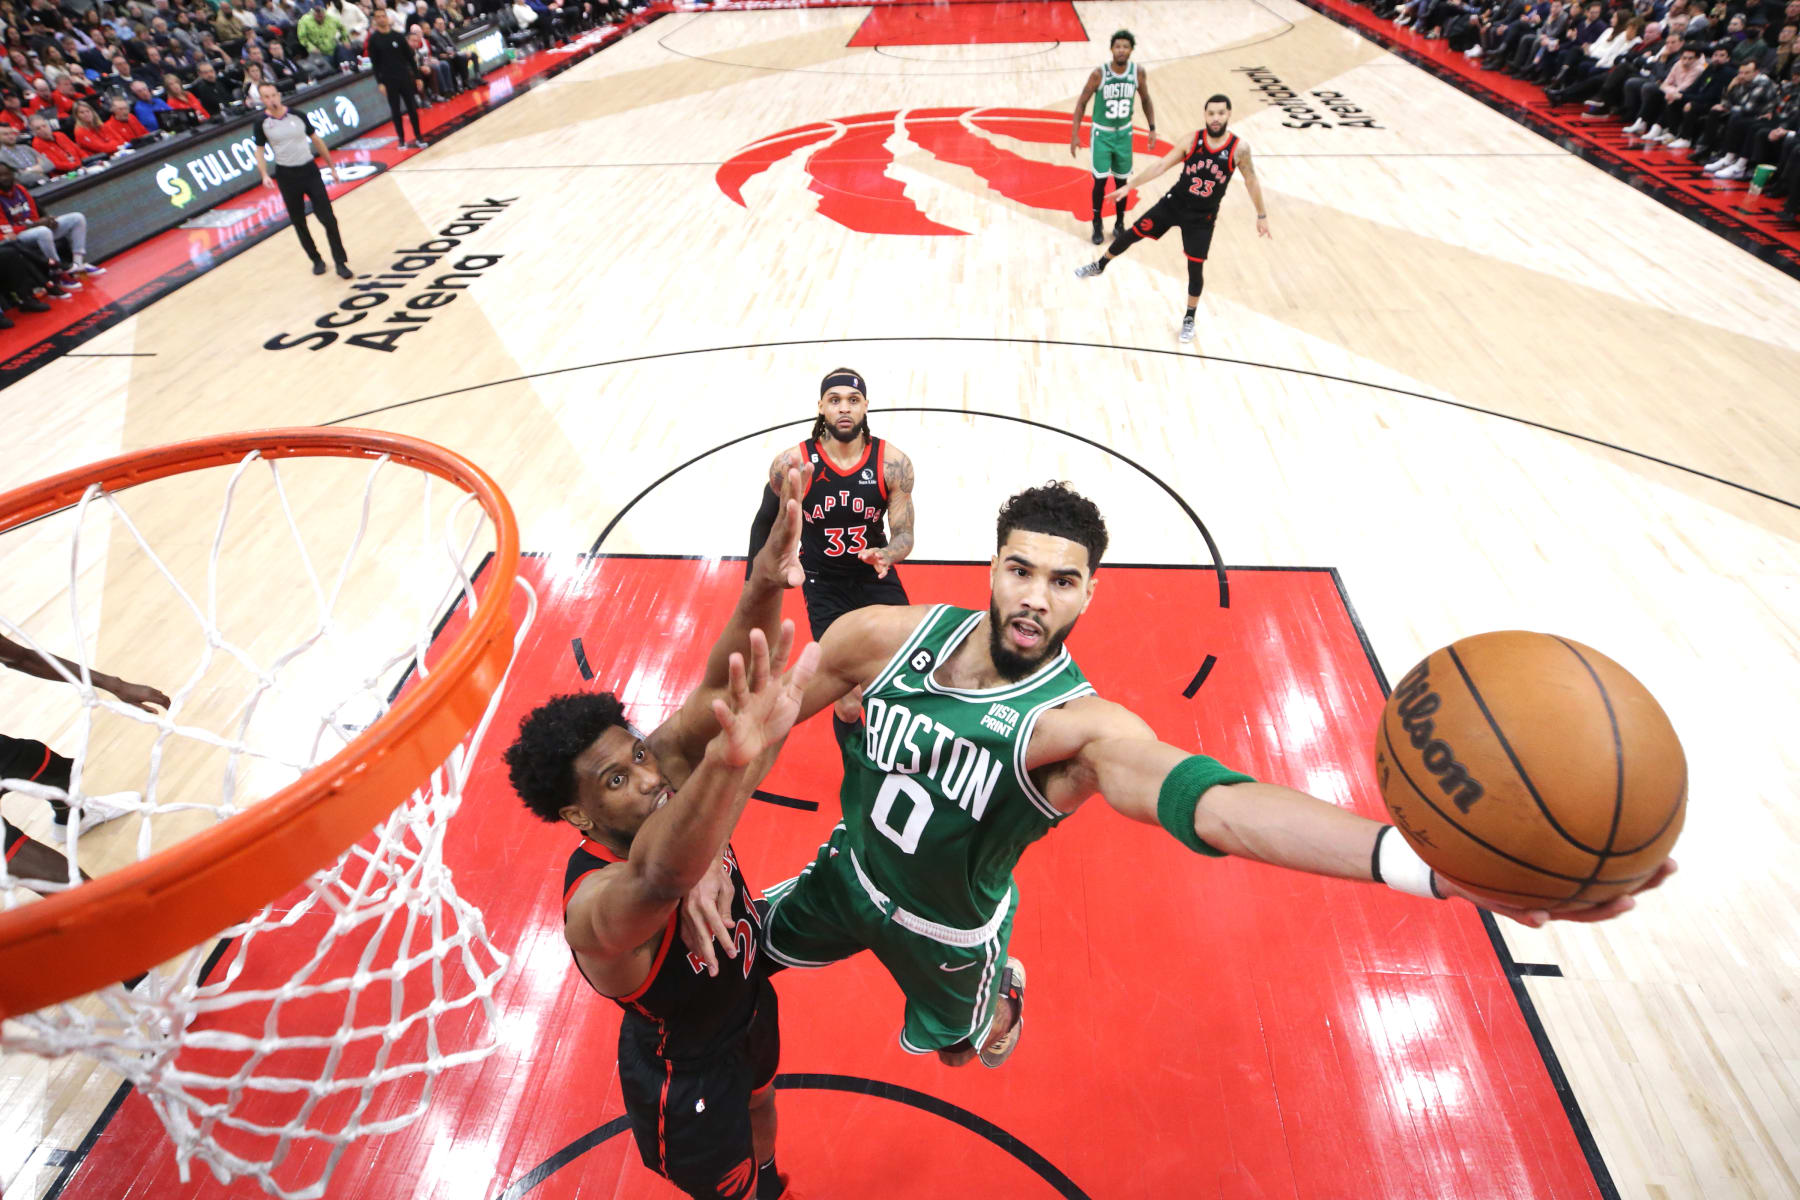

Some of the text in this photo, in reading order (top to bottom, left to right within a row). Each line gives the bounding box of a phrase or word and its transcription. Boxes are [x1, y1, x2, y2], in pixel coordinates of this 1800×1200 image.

[1103, 83, 1135, 99] BOSTON
[1105, 99, 1131, 119] 36
[1231, 66, 1332, 129] Scotiabank
[1310, 91, 1386, 129] Arena
[187, 150, 241, 191] FULL
[1189, 177, 1216, 197] 23
[263, 196, 520, 351] Scotiabank
[344, 254, 505, 353] Arena
[824, 525, 868, 557] 33
[911, 650, 932, 671] 6
[980, 715, 1015, 738] PRINT
[988, 702, 1021, 727] VISTA
[1394, 657, 1485, 814] Wilson
[866, 697, 1003, 822] BOSTON
[870, 774, 935, 855] 0
